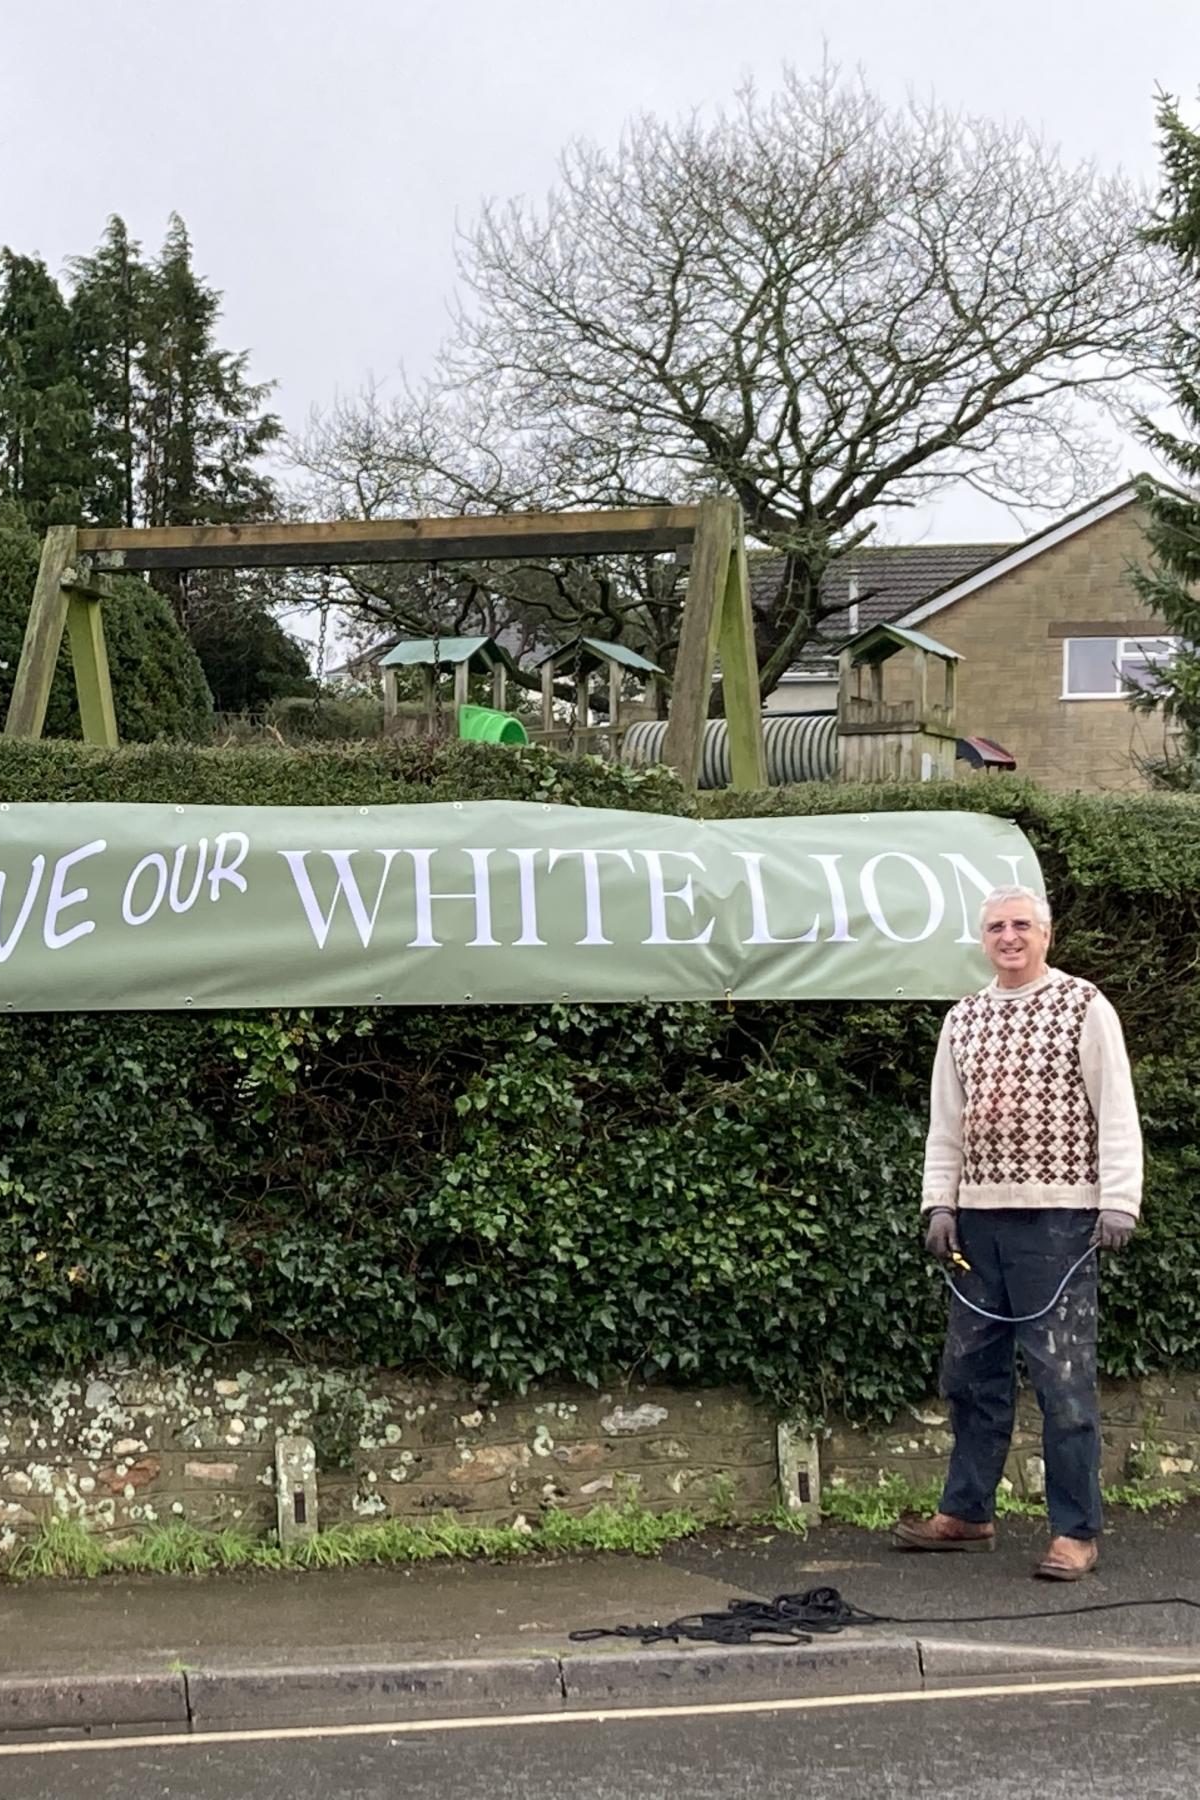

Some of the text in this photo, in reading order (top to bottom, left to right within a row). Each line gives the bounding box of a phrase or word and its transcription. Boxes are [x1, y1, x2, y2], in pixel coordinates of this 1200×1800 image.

[122, 832, 250, 926] OUR
[278, 847, 717, 950] WHITE
[732, 850, 1025, 946] LION
